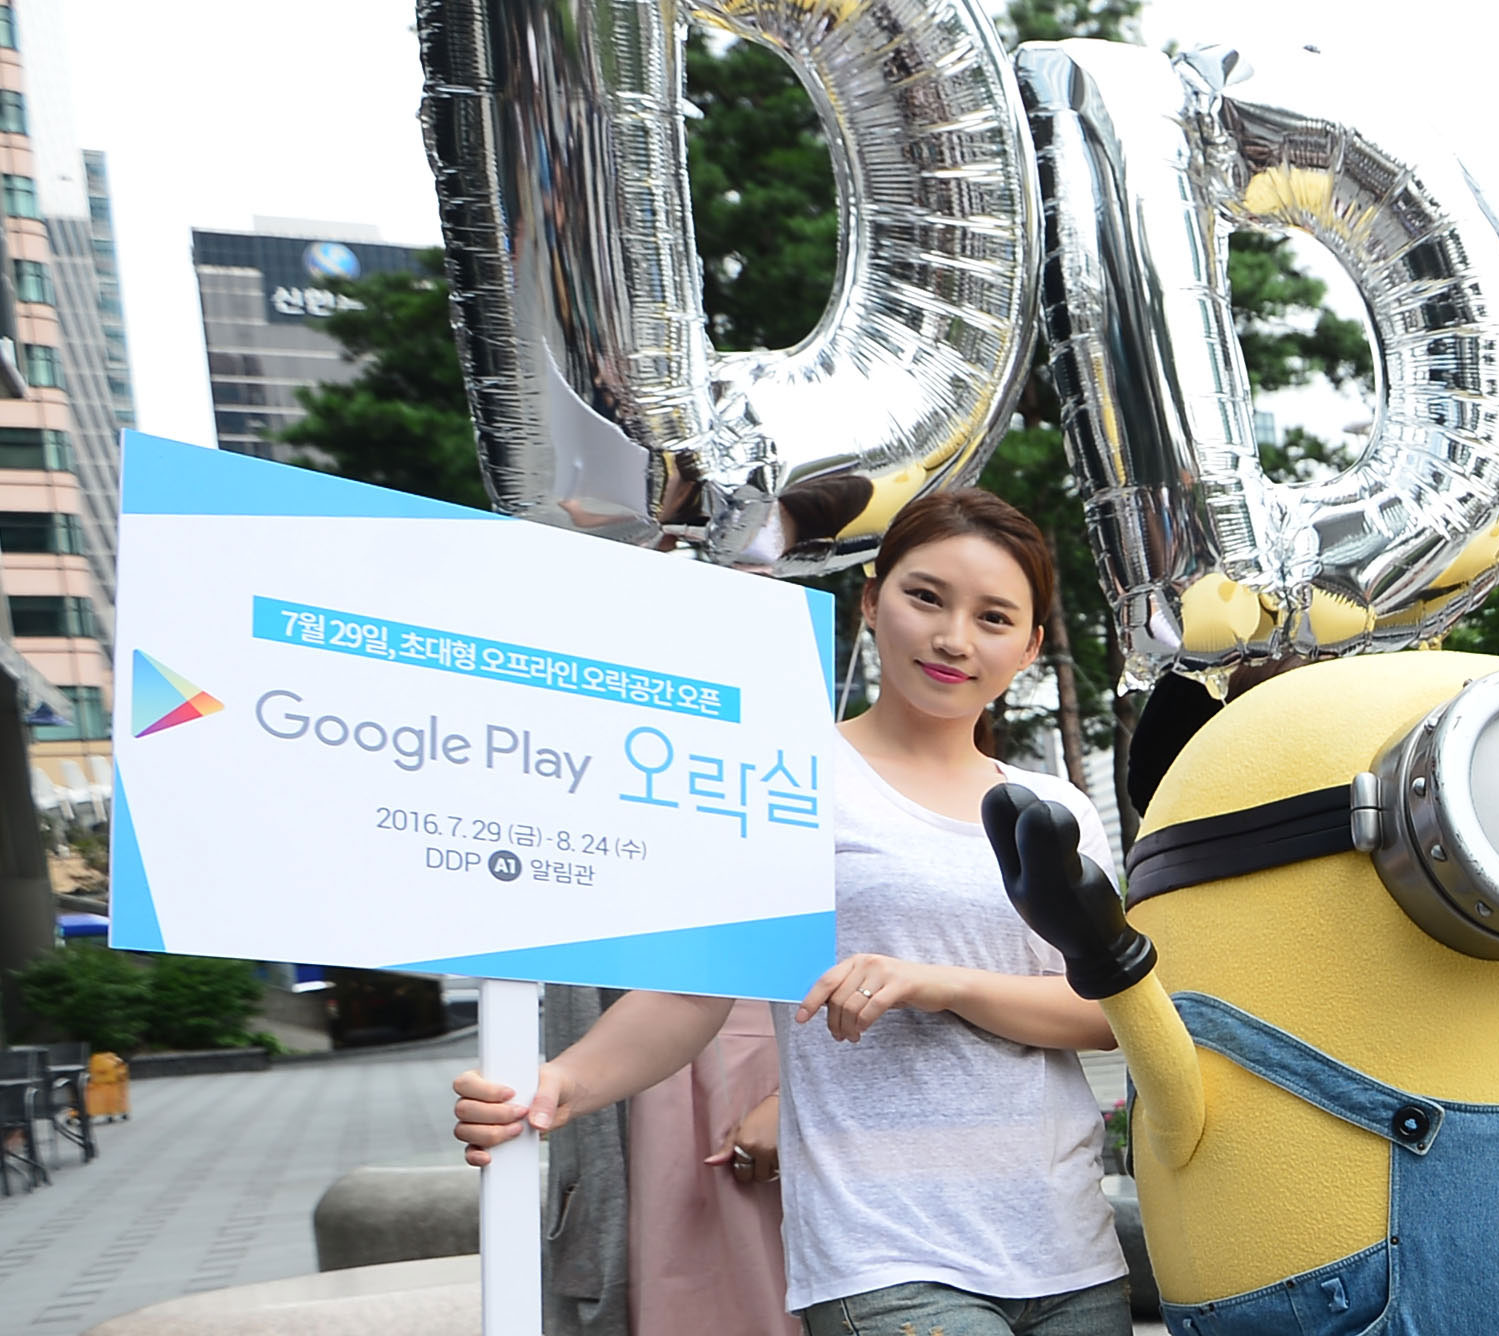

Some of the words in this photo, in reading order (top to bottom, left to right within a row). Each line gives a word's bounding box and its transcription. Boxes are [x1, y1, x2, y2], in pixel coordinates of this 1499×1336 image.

[281, 610, 325, 645] 7월
[329, 619, 396, 660] 29일,
[399, 632, 477, 671] 초대형
[480, 647, 578, 690] 오프라인
[581, 666, 675, 707] 오락공간
[676, 685, 721, 716] 오픈
[255, 689, 471, 772] Google
[486, 724, 592, 794] Play
[619, 726, 820, 838] 오락실
[426, 847, 481, 872] DDP
[493, 855, 518, 878] A1
[530, 859, 595, 887] 알림관
